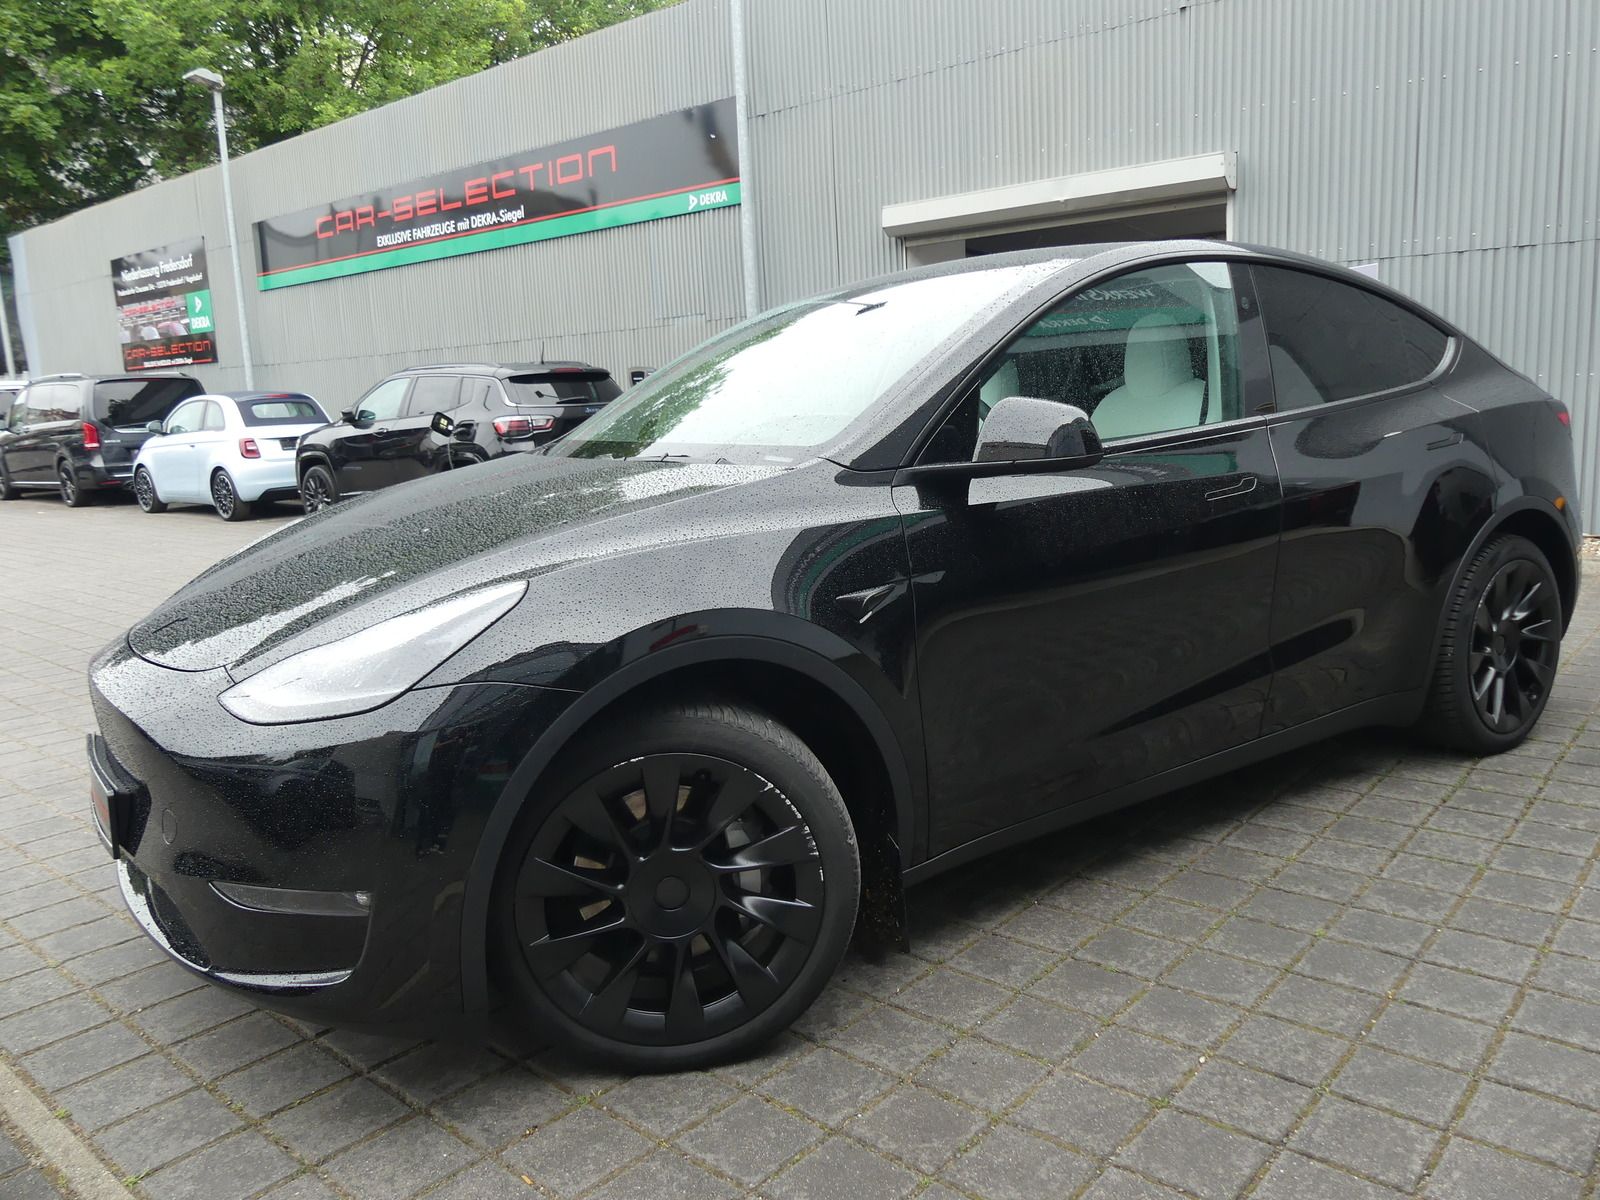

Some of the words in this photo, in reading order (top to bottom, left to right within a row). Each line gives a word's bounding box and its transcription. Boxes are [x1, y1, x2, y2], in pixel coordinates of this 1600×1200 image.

[315, 144, 617, 239] CAR-SELECTION
[699, 190, 728, 206] DEKRA
[376, 229, 413, 247] EXKLUSIVE
[412, 220, 456, 240] FAHRZEUGE
[457, 217, 470, 231] mit
[471, 204, 525, 229] DEKRA-Siegel
[160, 253, 192, 274] Fredersdorf
[190, 315, 211, 330] DEKRA
[126, 340, 211, 360] CAR-SELECTION
